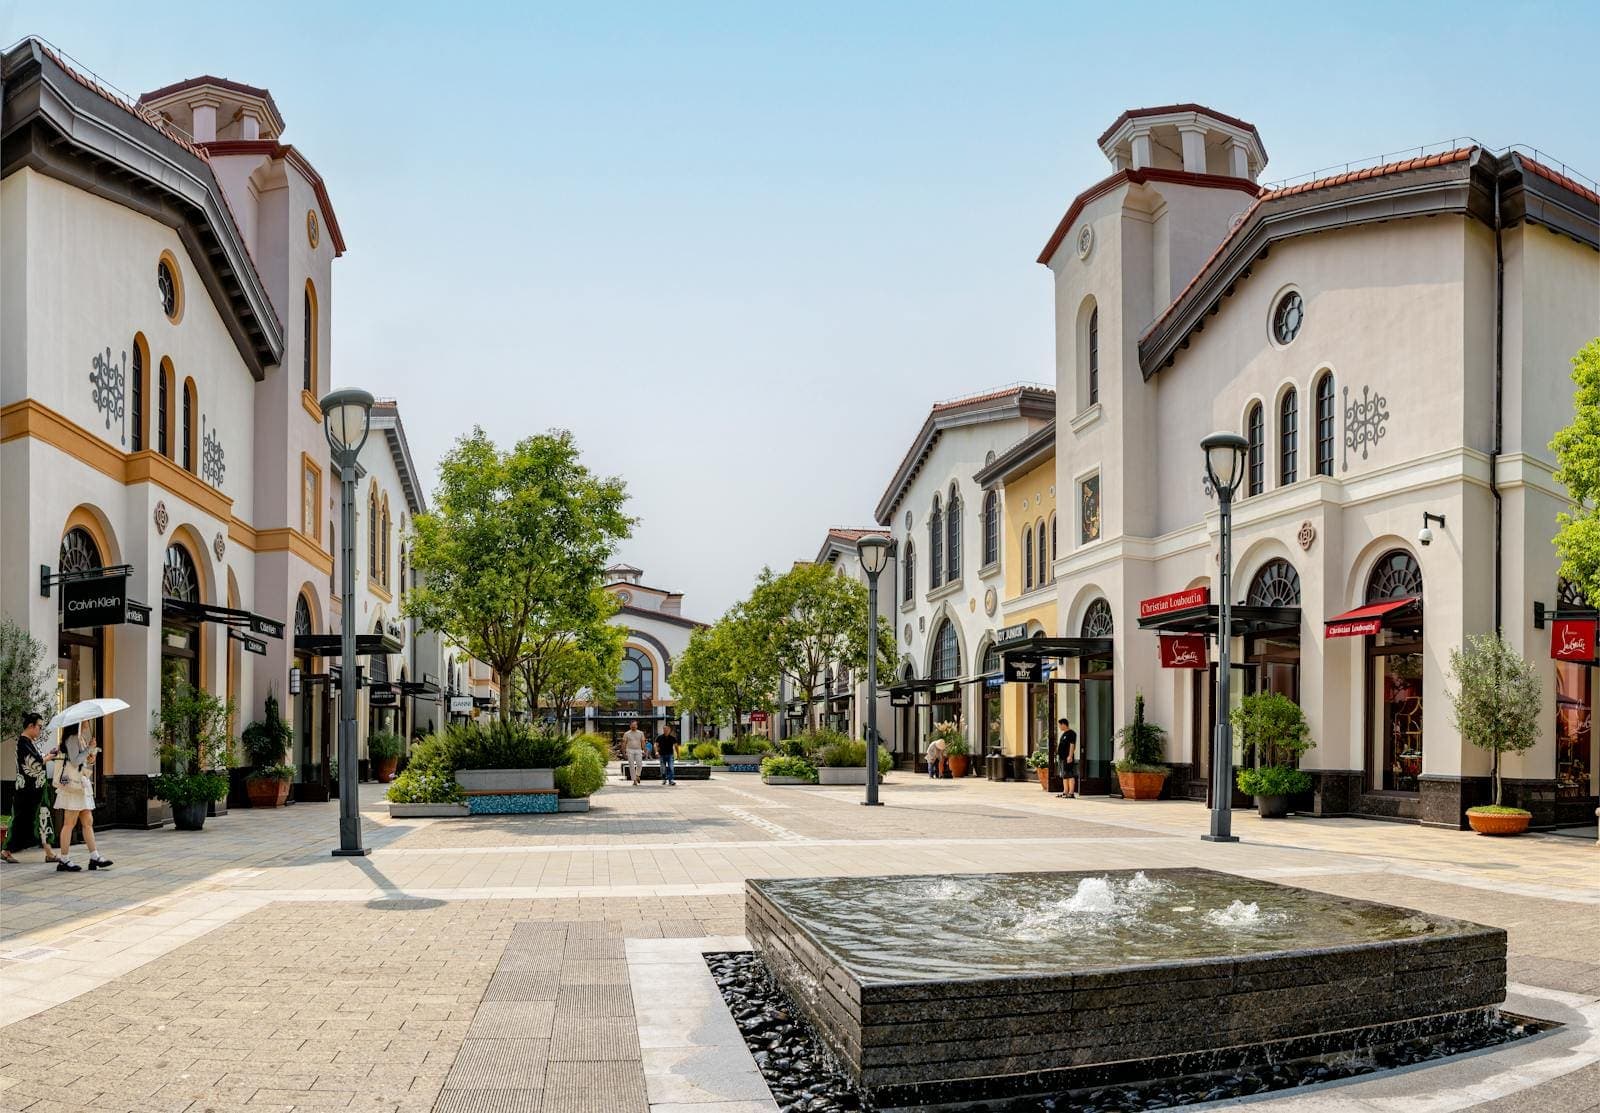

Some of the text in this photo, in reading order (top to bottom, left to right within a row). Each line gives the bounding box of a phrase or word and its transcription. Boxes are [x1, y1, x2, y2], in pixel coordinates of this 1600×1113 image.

[68, 596, 120, 611] Calvin Klein
[1142, 593, 1202, 614] Christian Louboutin
